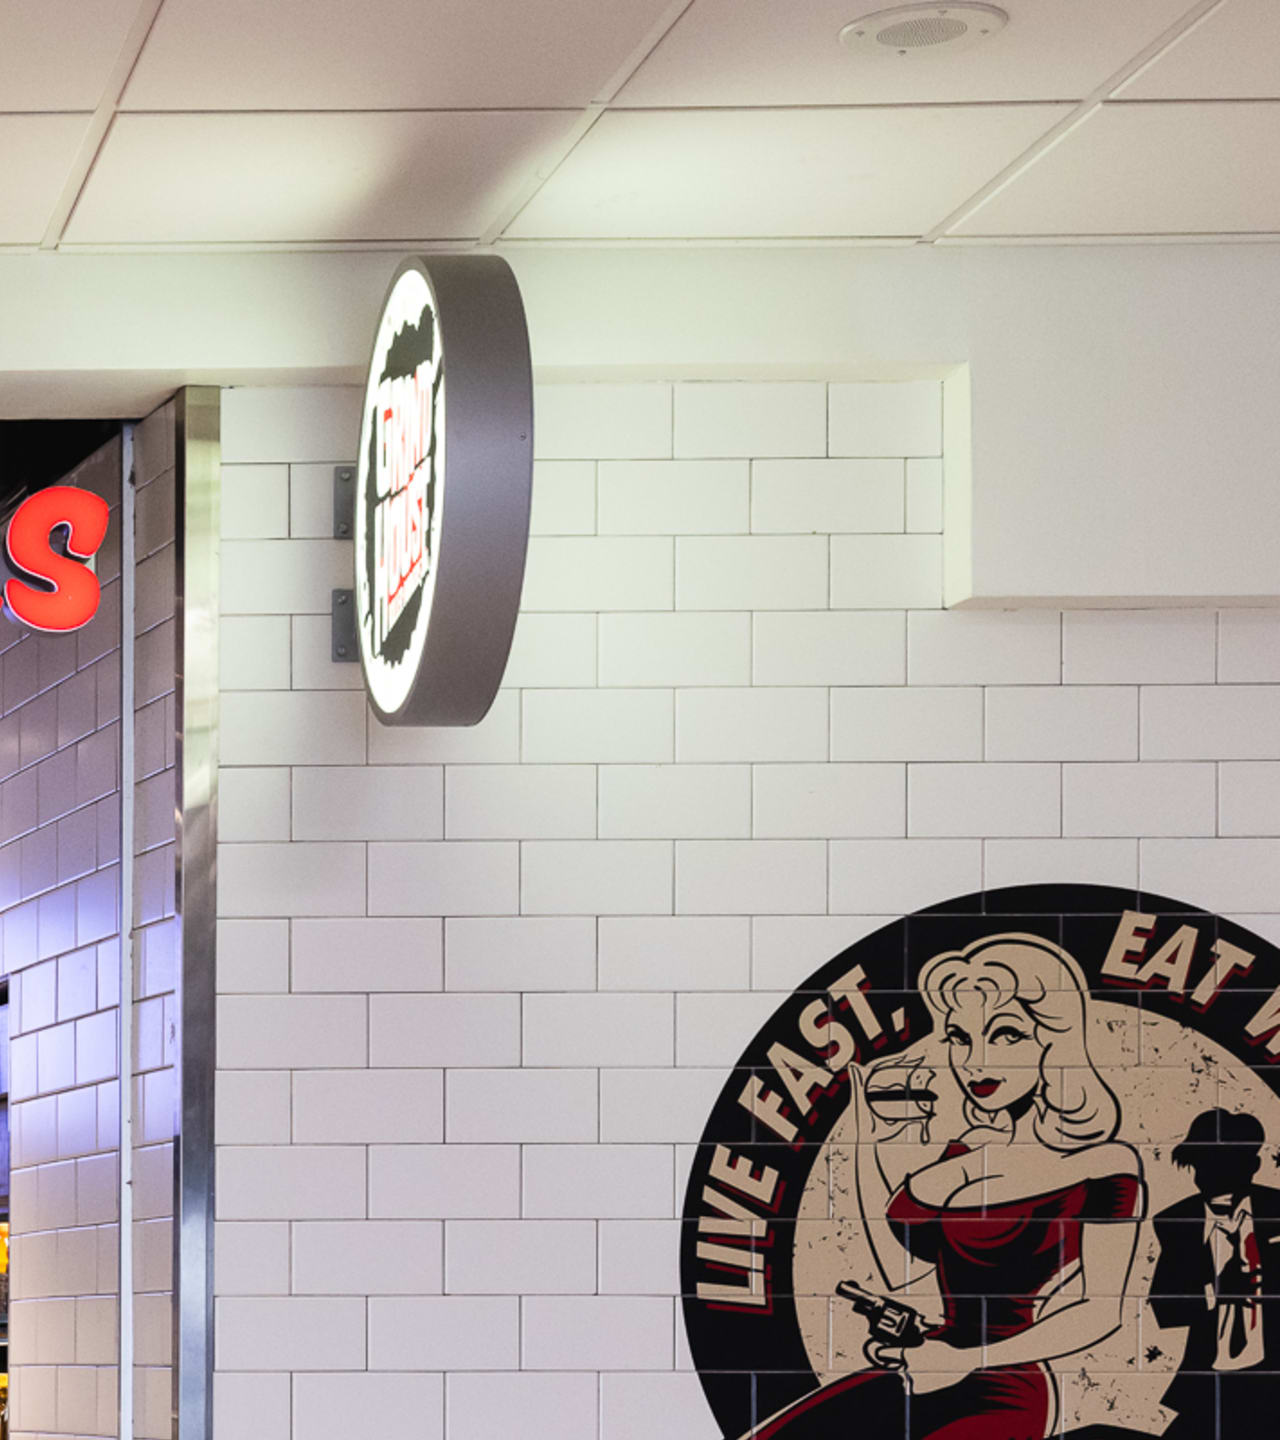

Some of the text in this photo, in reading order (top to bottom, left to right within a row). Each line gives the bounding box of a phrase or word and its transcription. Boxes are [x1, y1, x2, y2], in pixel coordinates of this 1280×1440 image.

[696, 908, 1257, 1314] LIVE FAST, EAT
